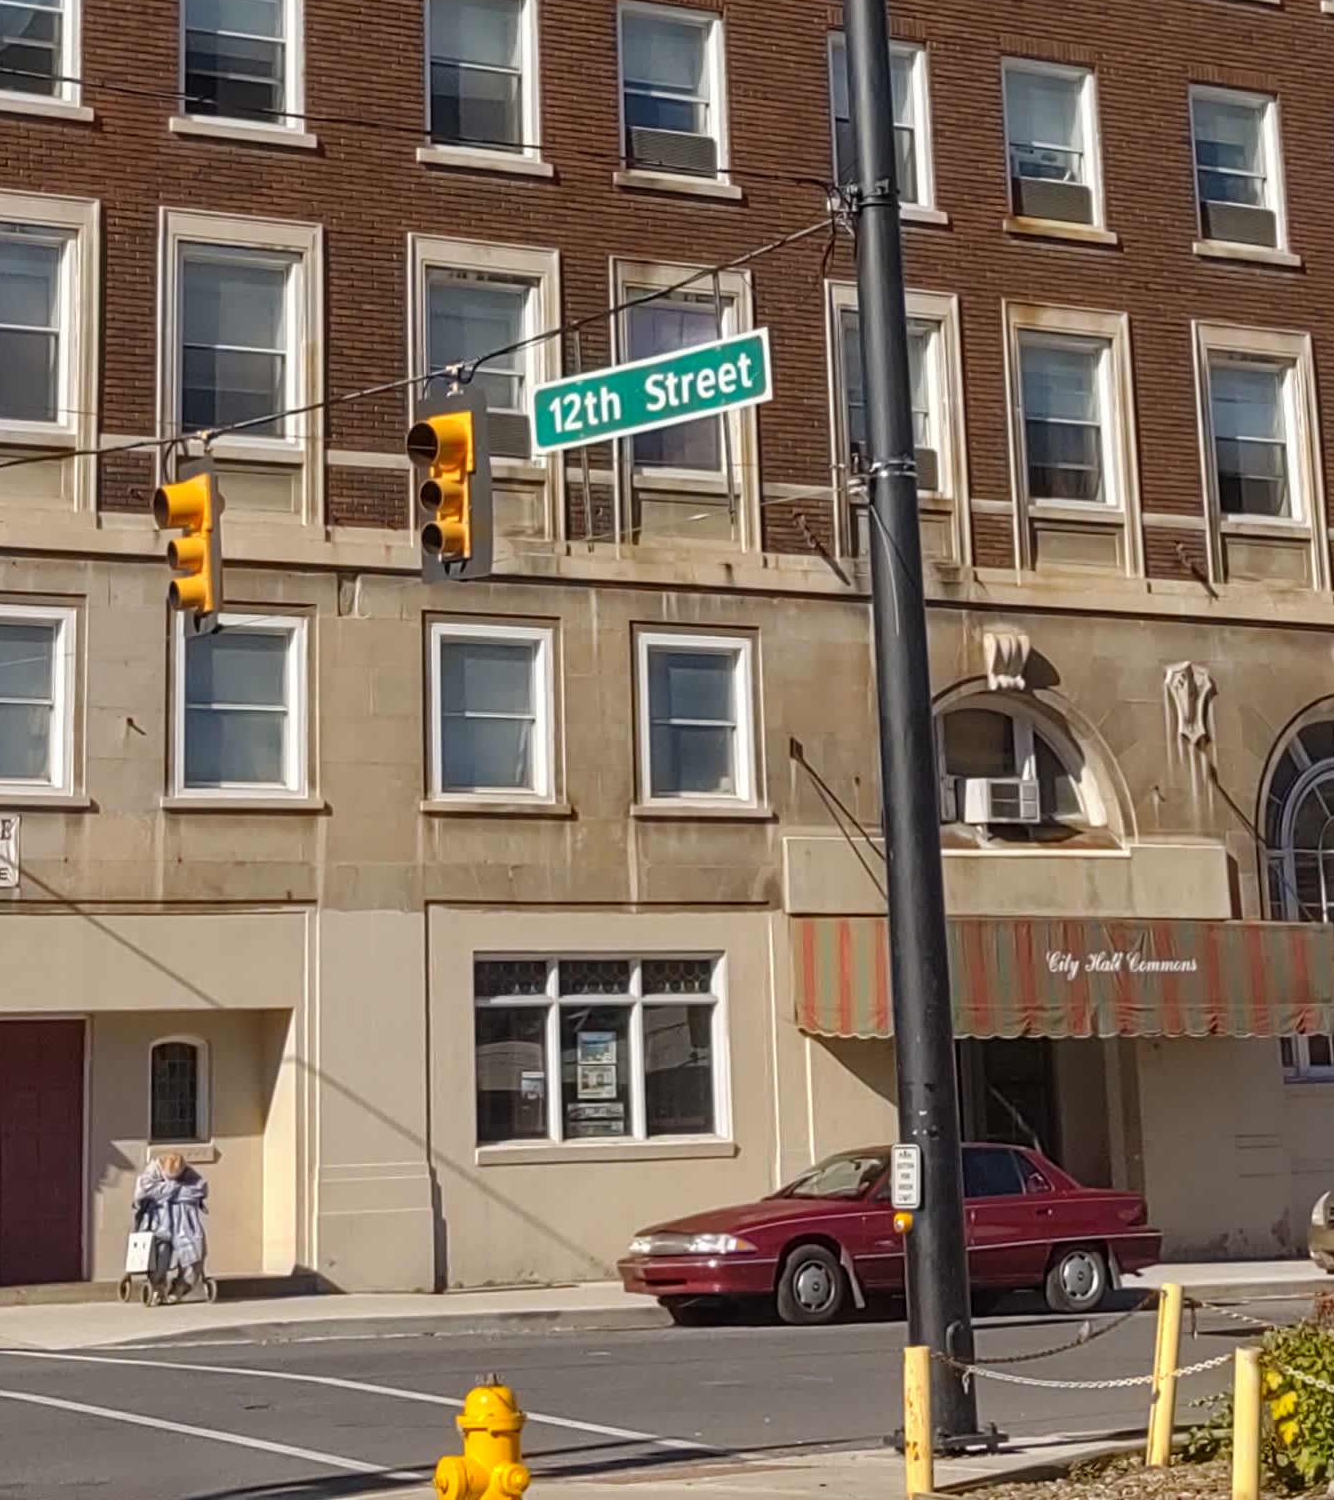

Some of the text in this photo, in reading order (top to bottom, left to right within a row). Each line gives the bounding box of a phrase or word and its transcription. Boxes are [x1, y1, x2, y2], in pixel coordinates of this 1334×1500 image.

[548, 352, 752, 434] 12th Street
[1046, 951, 1198, 981] City Hall Commons
